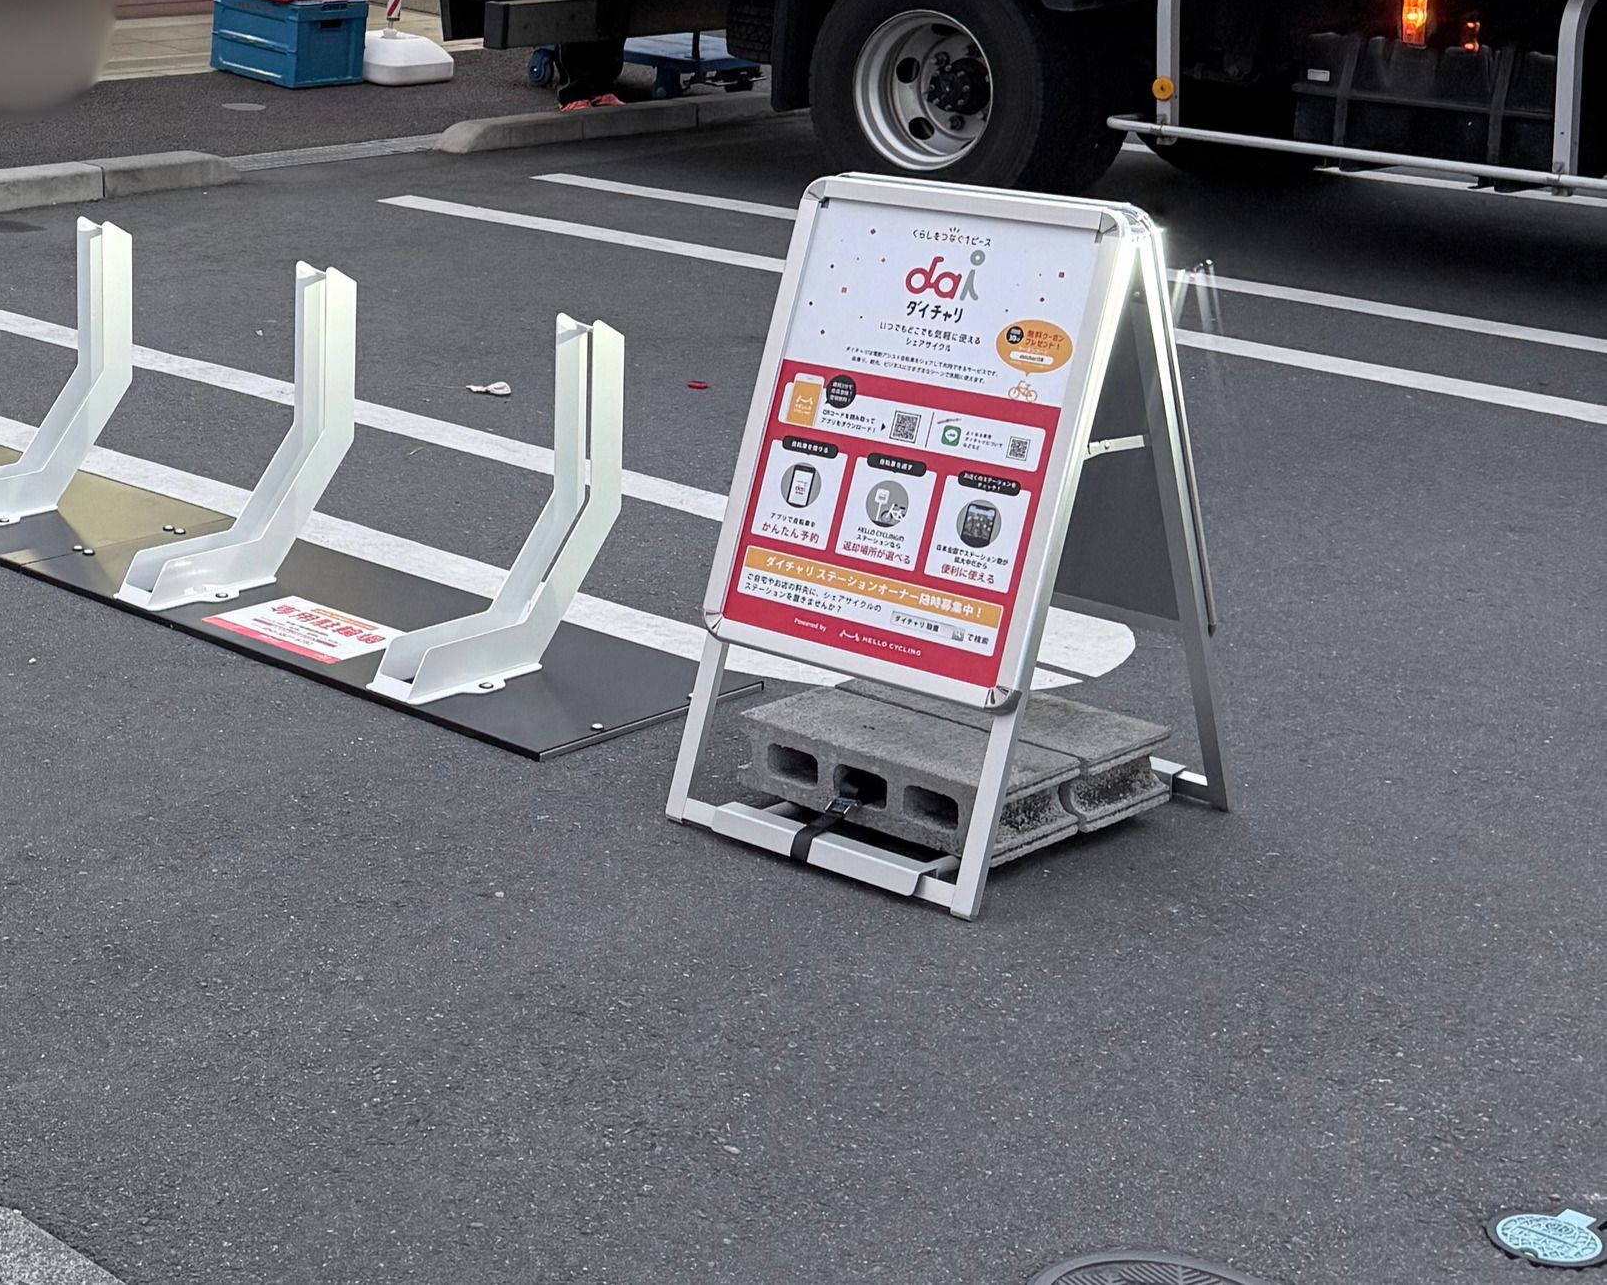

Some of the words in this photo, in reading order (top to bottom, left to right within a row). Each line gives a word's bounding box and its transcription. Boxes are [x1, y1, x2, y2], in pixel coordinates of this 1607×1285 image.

[906, 300, 964, 324] ダイチャリ
[879, 321, 982, 346] いつでもどこでも気軽に使える
[905, 337, 951, 353] シェアサイクル
[770, 512, 816, 528] アプリで自転車を
[761, 521, 819, 544] かんたん予約
[842, 541, 911, 565] 返却場所が選べる
[765, 555, 815, 578] ダイチャリ
[940, 563, 995, 585] 便利に使える
[744, 585, 842, 613] ステーションを置きませんか？
[747, 572, 882, 613] ご自宅やお店の軒先に、シェアサイクルの
[793, 617, 818, 630] Powered
[818, 623, 827, 633] by
[861, 636, 888, 649] HELLO
[889, 642, 922, 657] CYCLING
